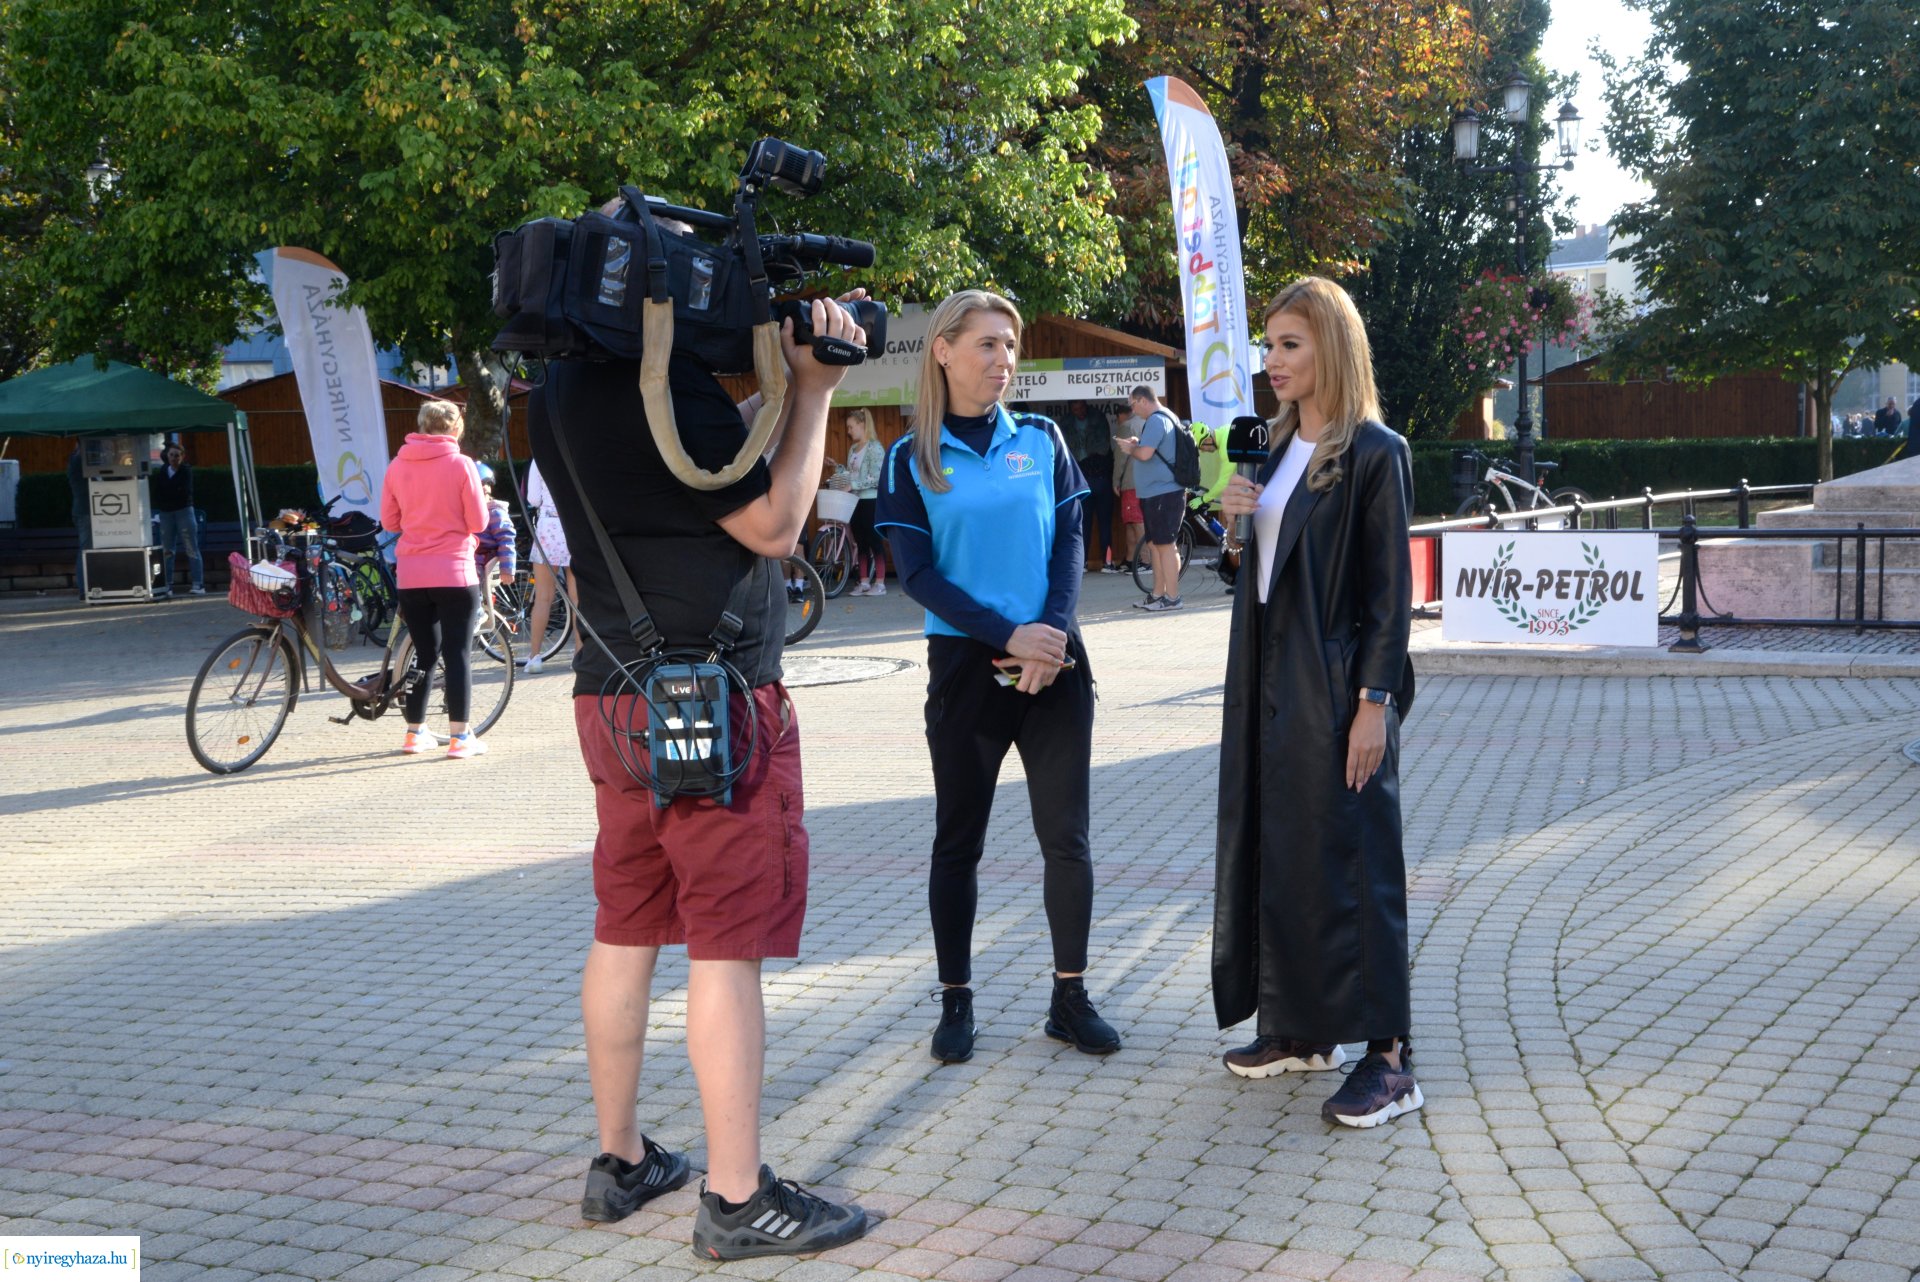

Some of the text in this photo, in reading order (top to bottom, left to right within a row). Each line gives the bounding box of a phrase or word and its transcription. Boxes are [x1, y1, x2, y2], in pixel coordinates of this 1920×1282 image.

[827, 344, 852, 357] Canon
[886, 336, 925, 354] GAVÁ
[1010, 372, 1047, 388] ETELŐ
[1067, 370, 1160, 384] REGISZTRÁCIÓS
[1455, 560, 1645, 603] NYÍR-PETROL
[1537, 608, 1560, 618] SINCE
[1528, 620, 1570, 636] 1993
